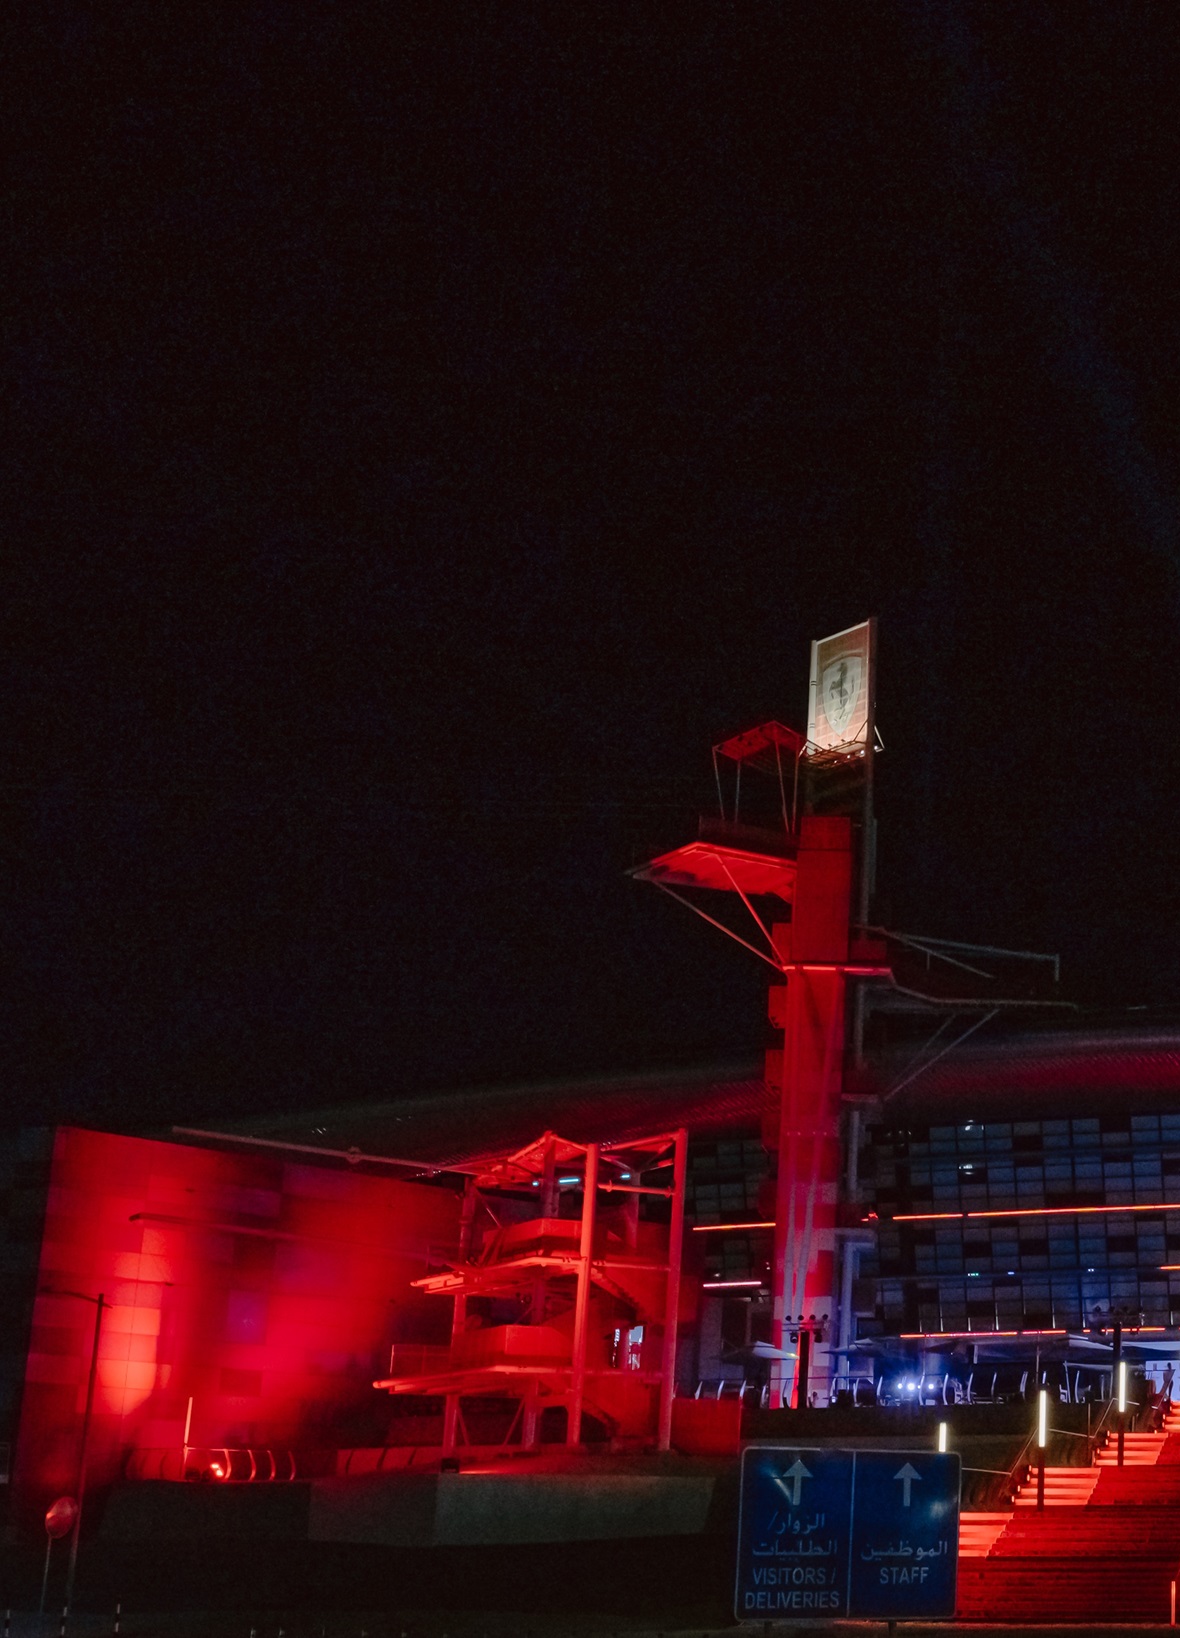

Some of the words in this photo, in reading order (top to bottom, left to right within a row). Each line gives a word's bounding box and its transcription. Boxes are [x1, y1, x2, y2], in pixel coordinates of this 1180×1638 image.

[860, 1540, 948, 1561] الموظفين
[753, 1567, 826, 1585] VISITORS
[880, 1566, 929, 1585] STAFF
[744, 1590, 840, 1610] DELIVERIES
